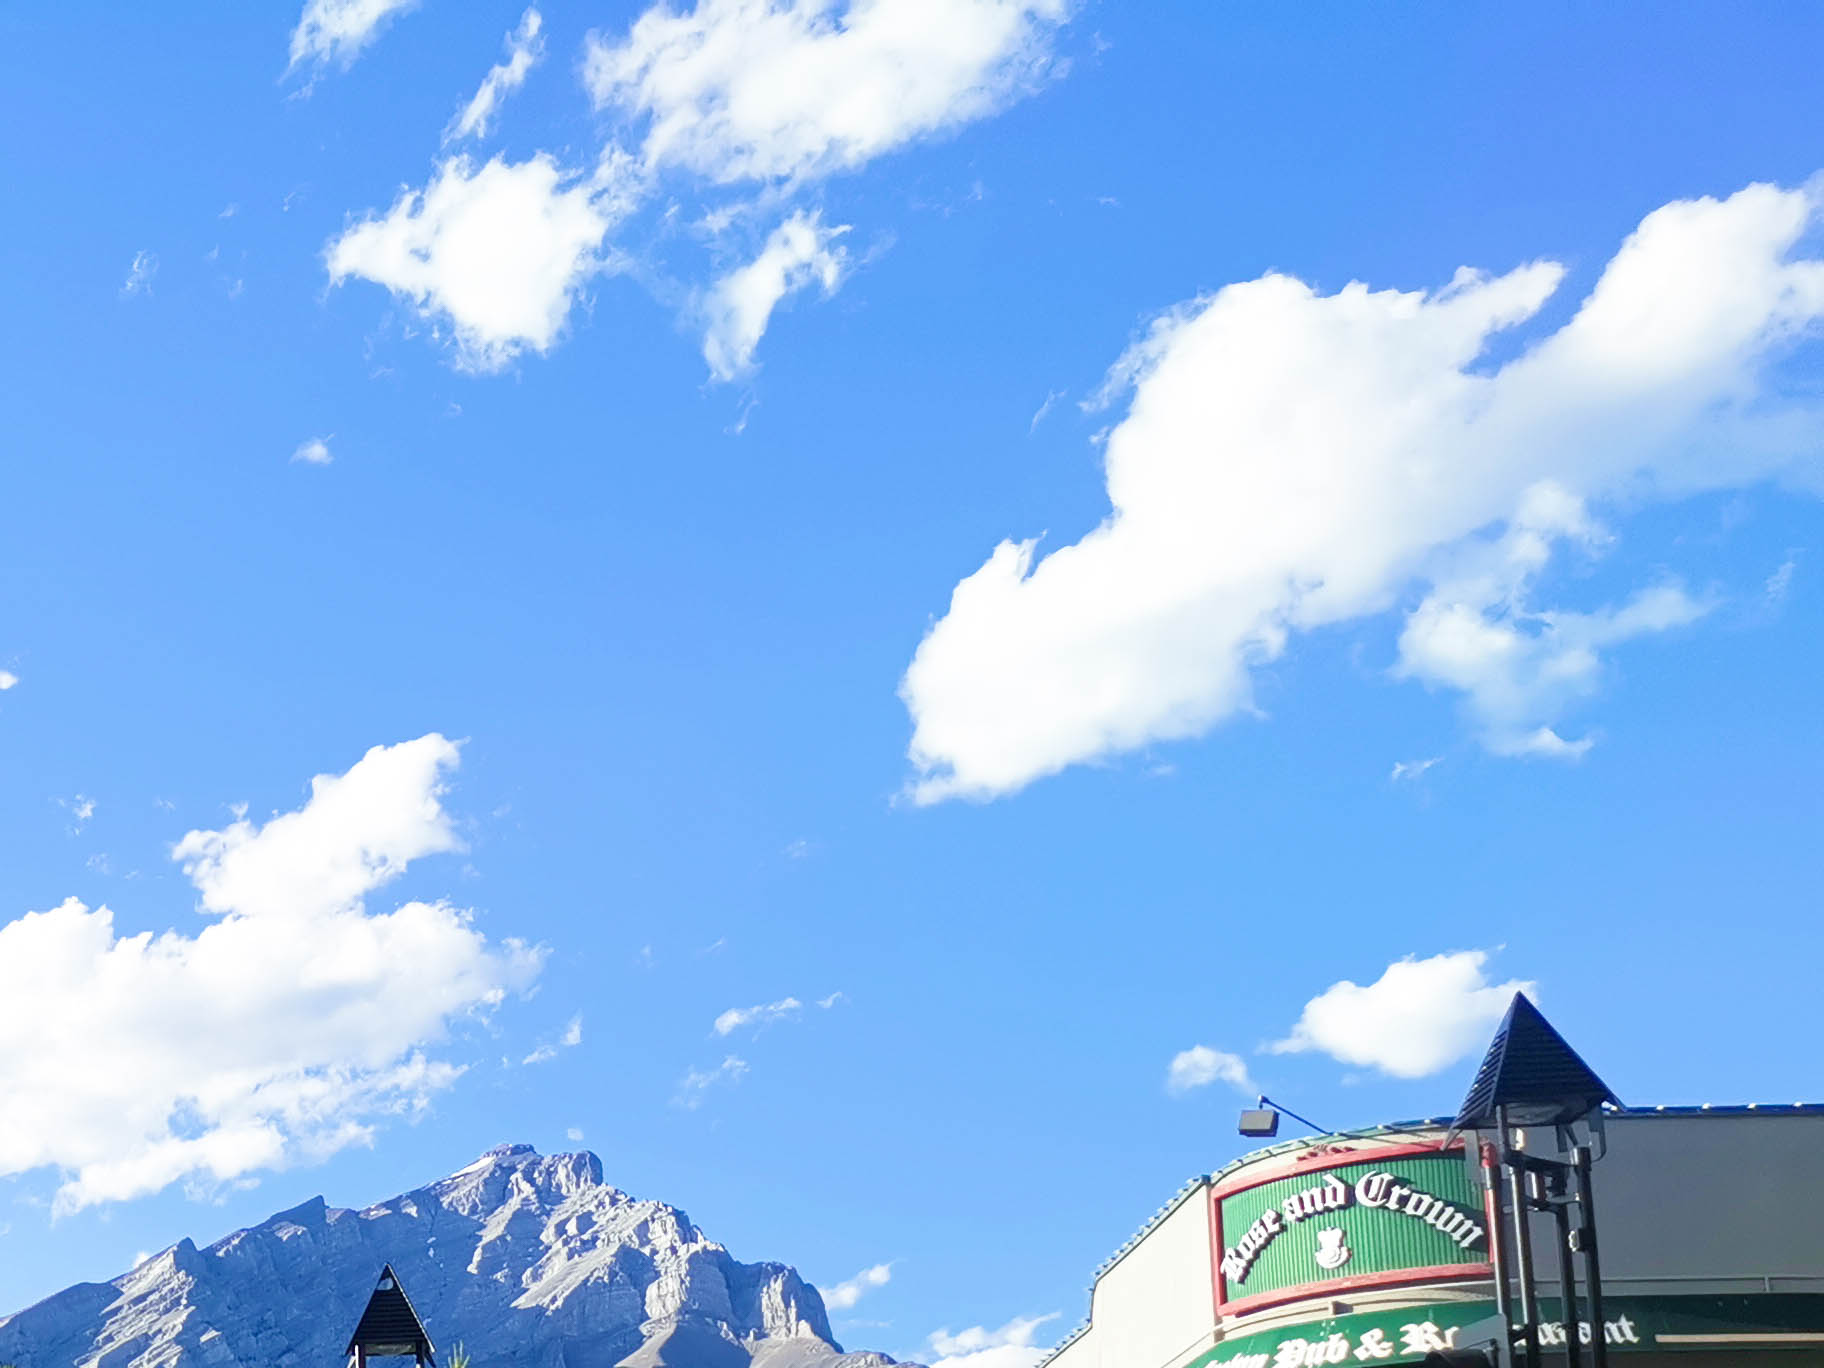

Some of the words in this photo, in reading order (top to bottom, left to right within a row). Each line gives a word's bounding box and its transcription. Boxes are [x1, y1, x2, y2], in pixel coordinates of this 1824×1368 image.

[1220, 1208, 1282, 1284] Rose
[1282, 1172, 1347, 1223] and
[1354, 1170, 1485, 1249] Crown
[1354, 1327, 1395, 1361] &
